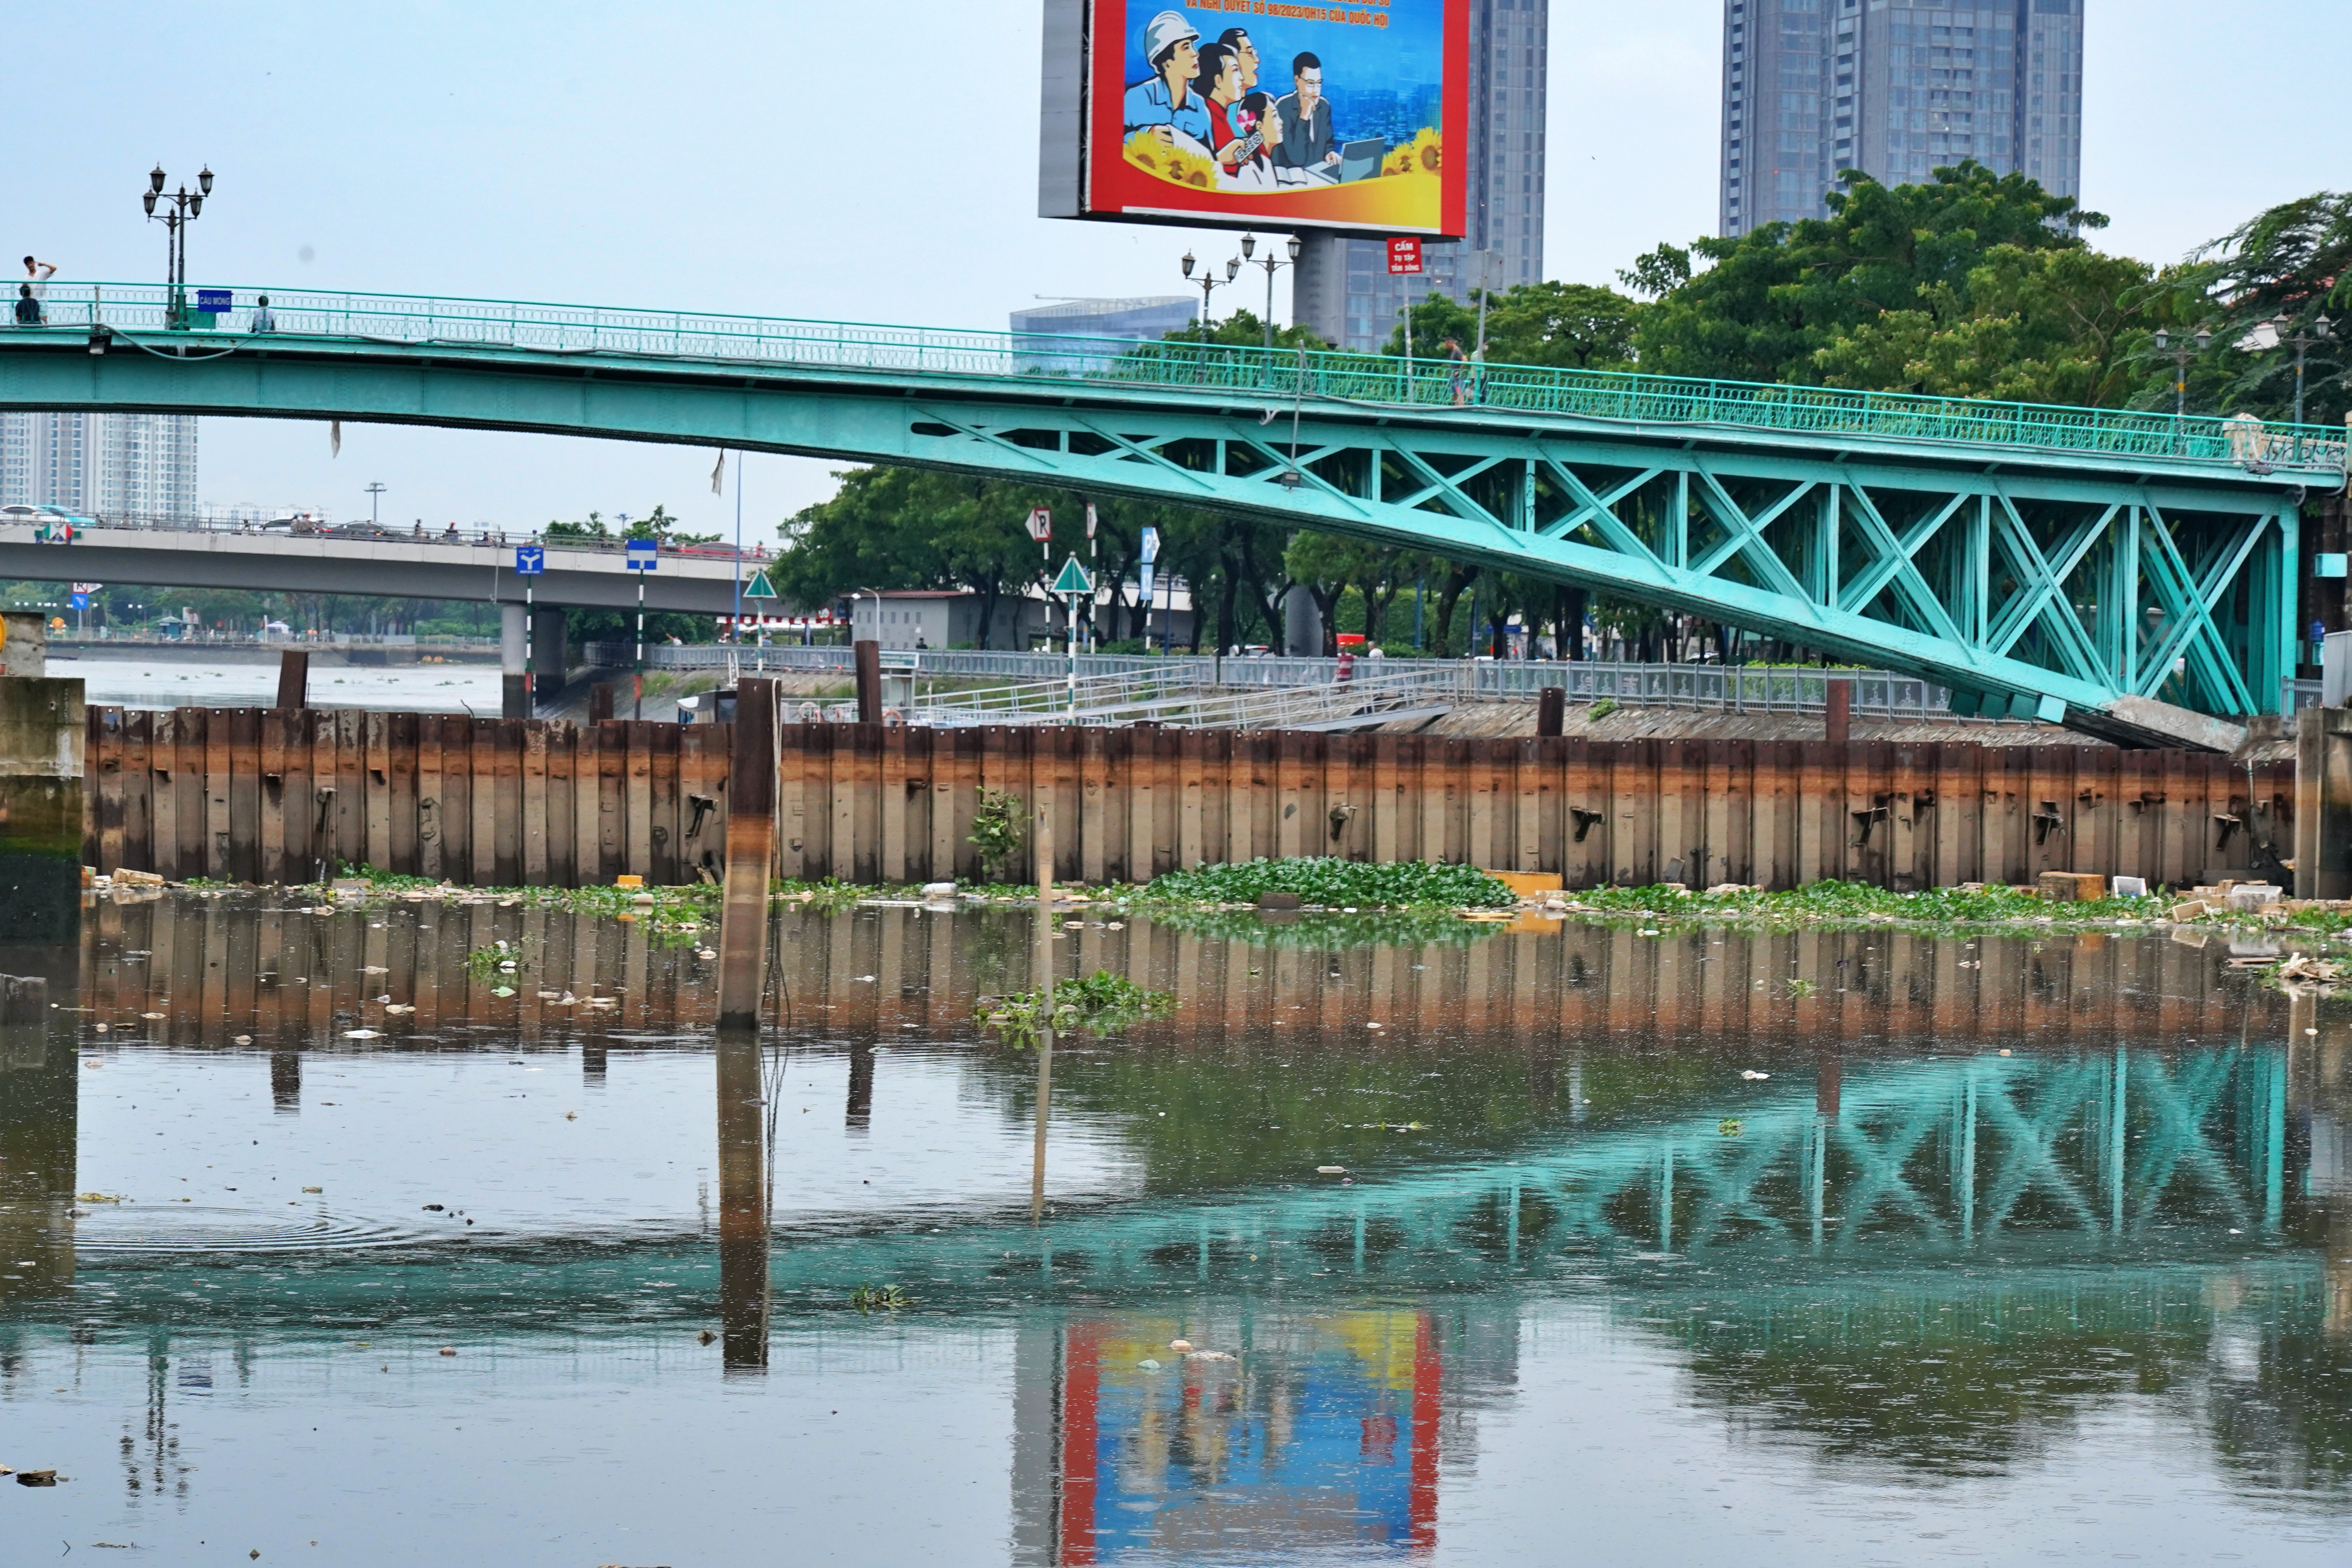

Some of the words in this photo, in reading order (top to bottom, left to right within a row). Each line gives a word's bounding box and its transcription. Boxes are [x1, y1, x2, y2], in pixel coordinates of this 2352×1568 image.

[1253, 0, 1265, 14] SỐ
[1267, 3, 1327, 21] 98/2023/QH15
[1328, 6, 1347, 23] CỦA
[1348, 8, 1371, 25] QUỐC
[1373, 12, 1388, 29] HỘI
[1395, 240, 1413, 251] CẤM
[1144, 534, 1152, 557] P
